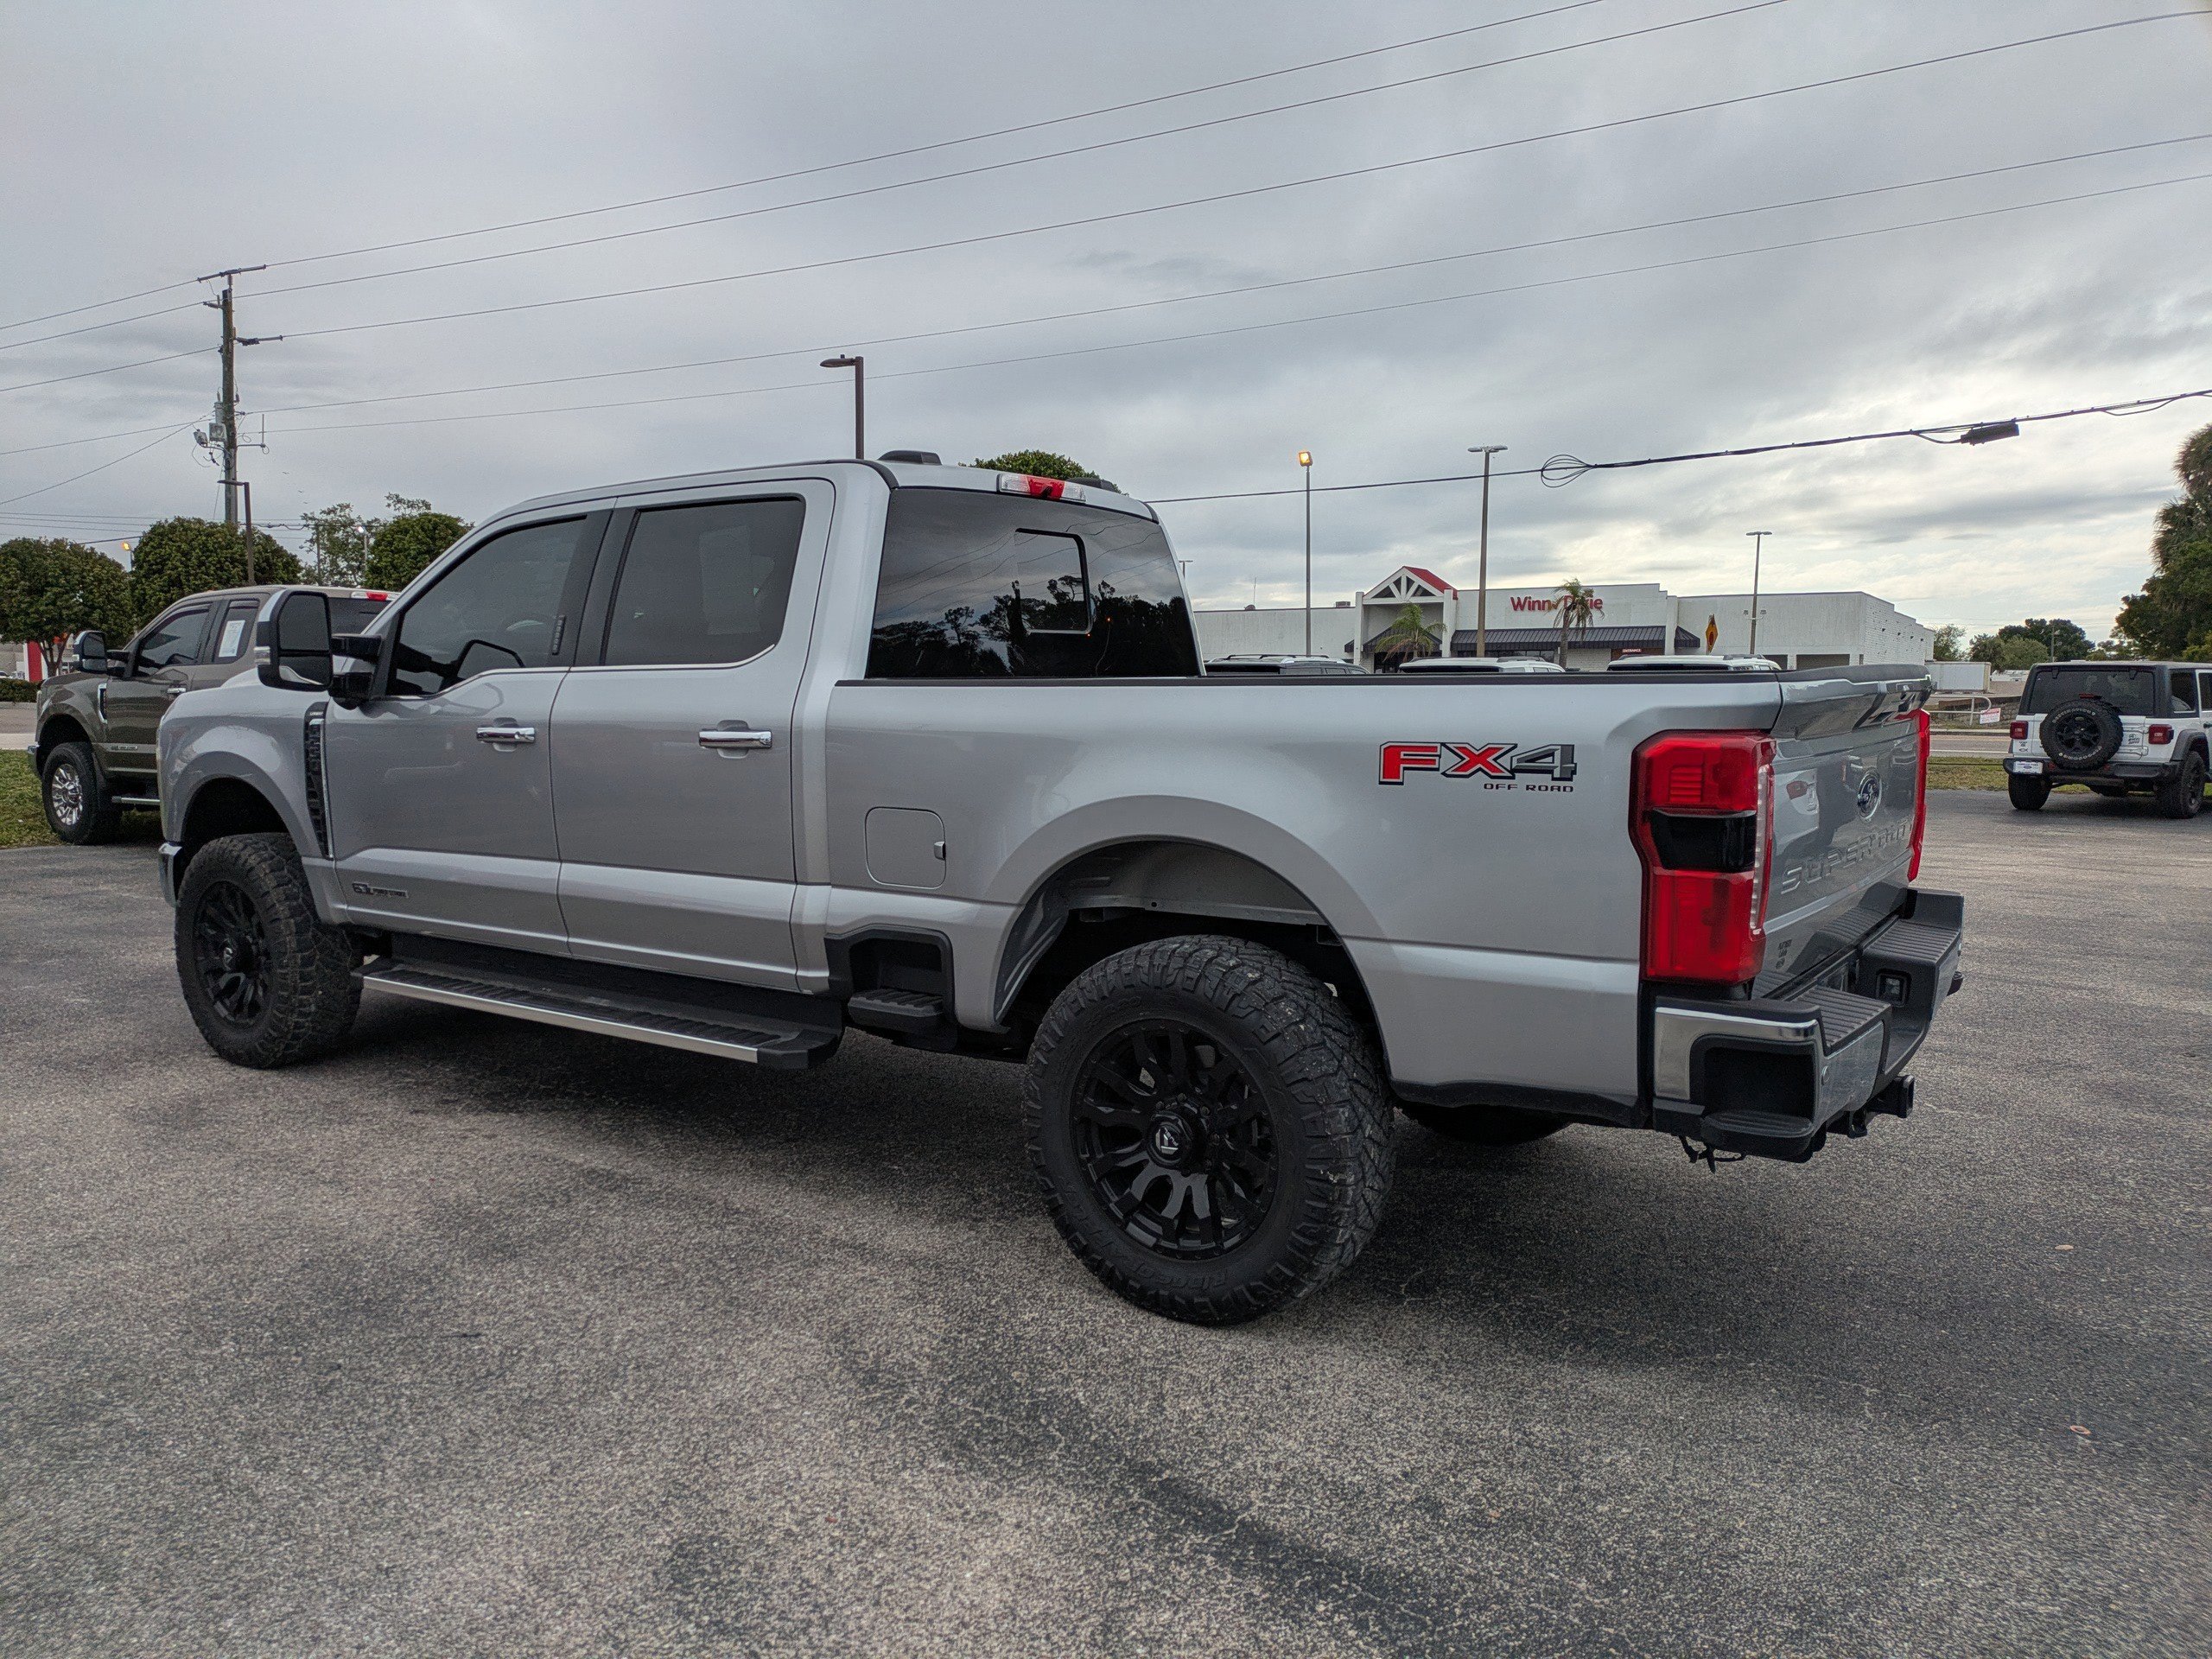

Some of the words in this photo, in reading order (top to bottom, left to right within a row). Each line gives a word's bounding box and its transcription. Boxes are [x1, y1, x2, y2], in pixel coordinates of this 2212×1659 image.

[1510, 595, 1553, 612] Winn
[1379, 741, 1577, 785] FX4
[1525, 784, 1574, 792] ROAD
[1781, 834, 1876, 895] SUPER
